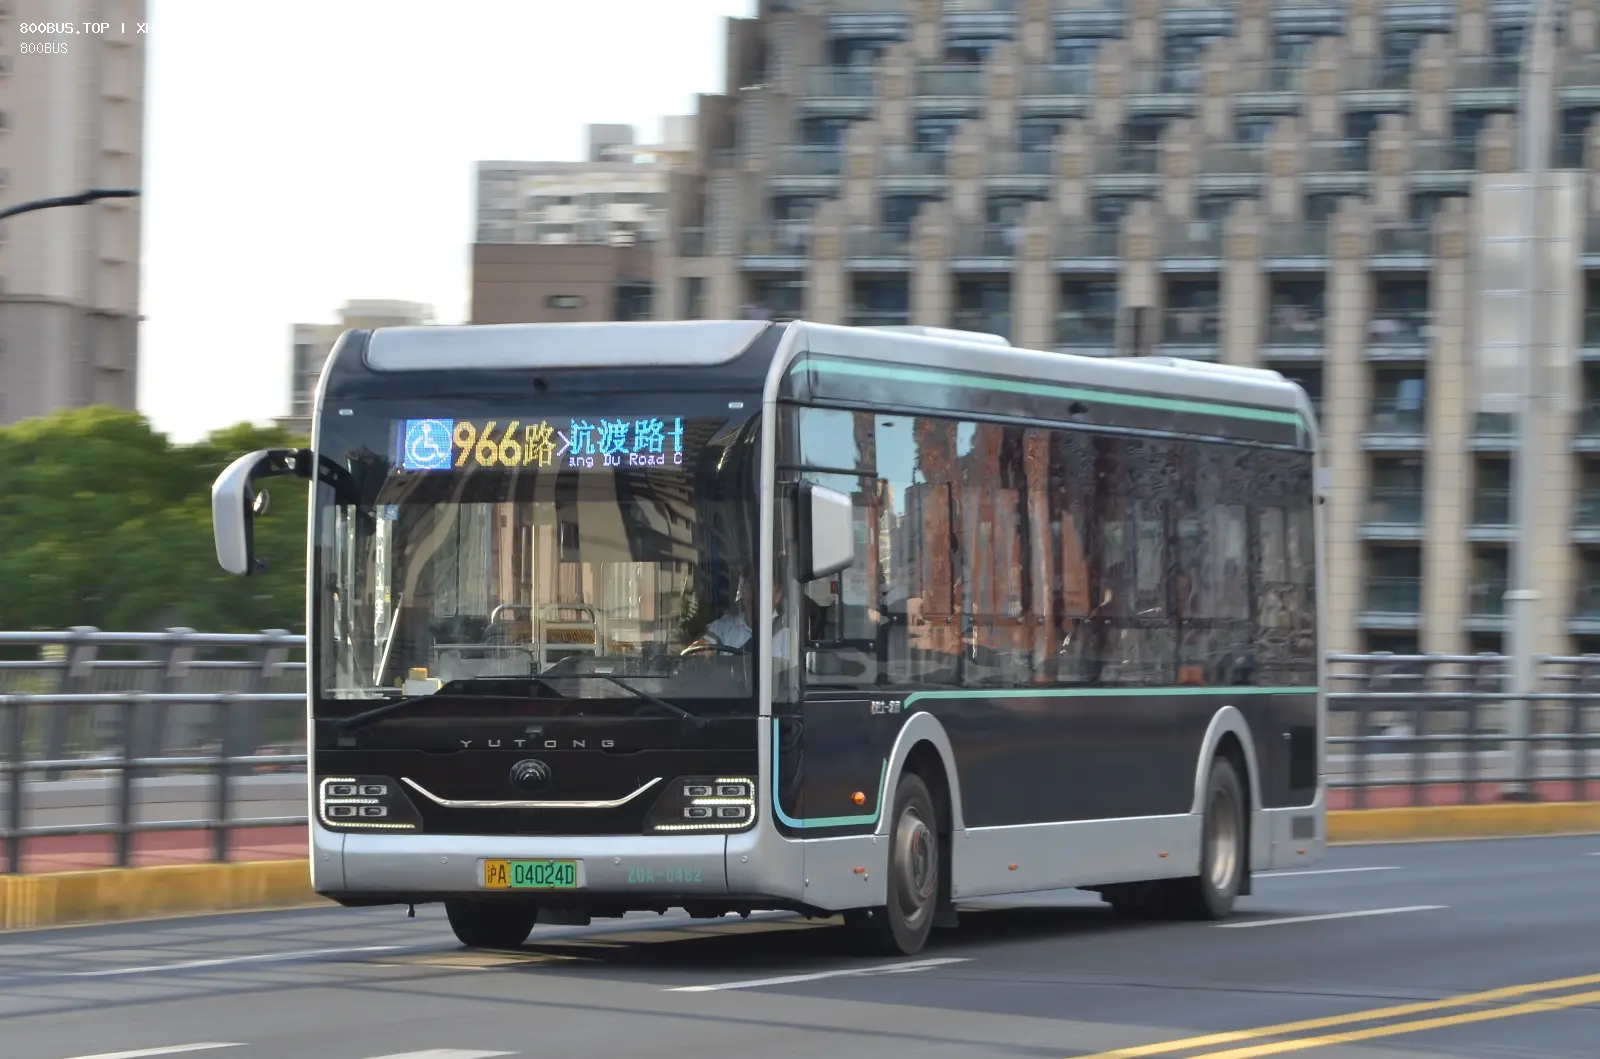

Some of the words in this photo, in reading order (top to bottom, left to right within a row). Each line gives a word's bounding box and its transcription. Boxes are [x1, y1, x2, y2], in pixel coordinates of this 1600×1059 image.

[453, 420, 556, 467] 966路
[629, 452, 665, 466] Road
[460, 739, 615, 748] YUTONG
[515, 864, 574, 884] 04024D
